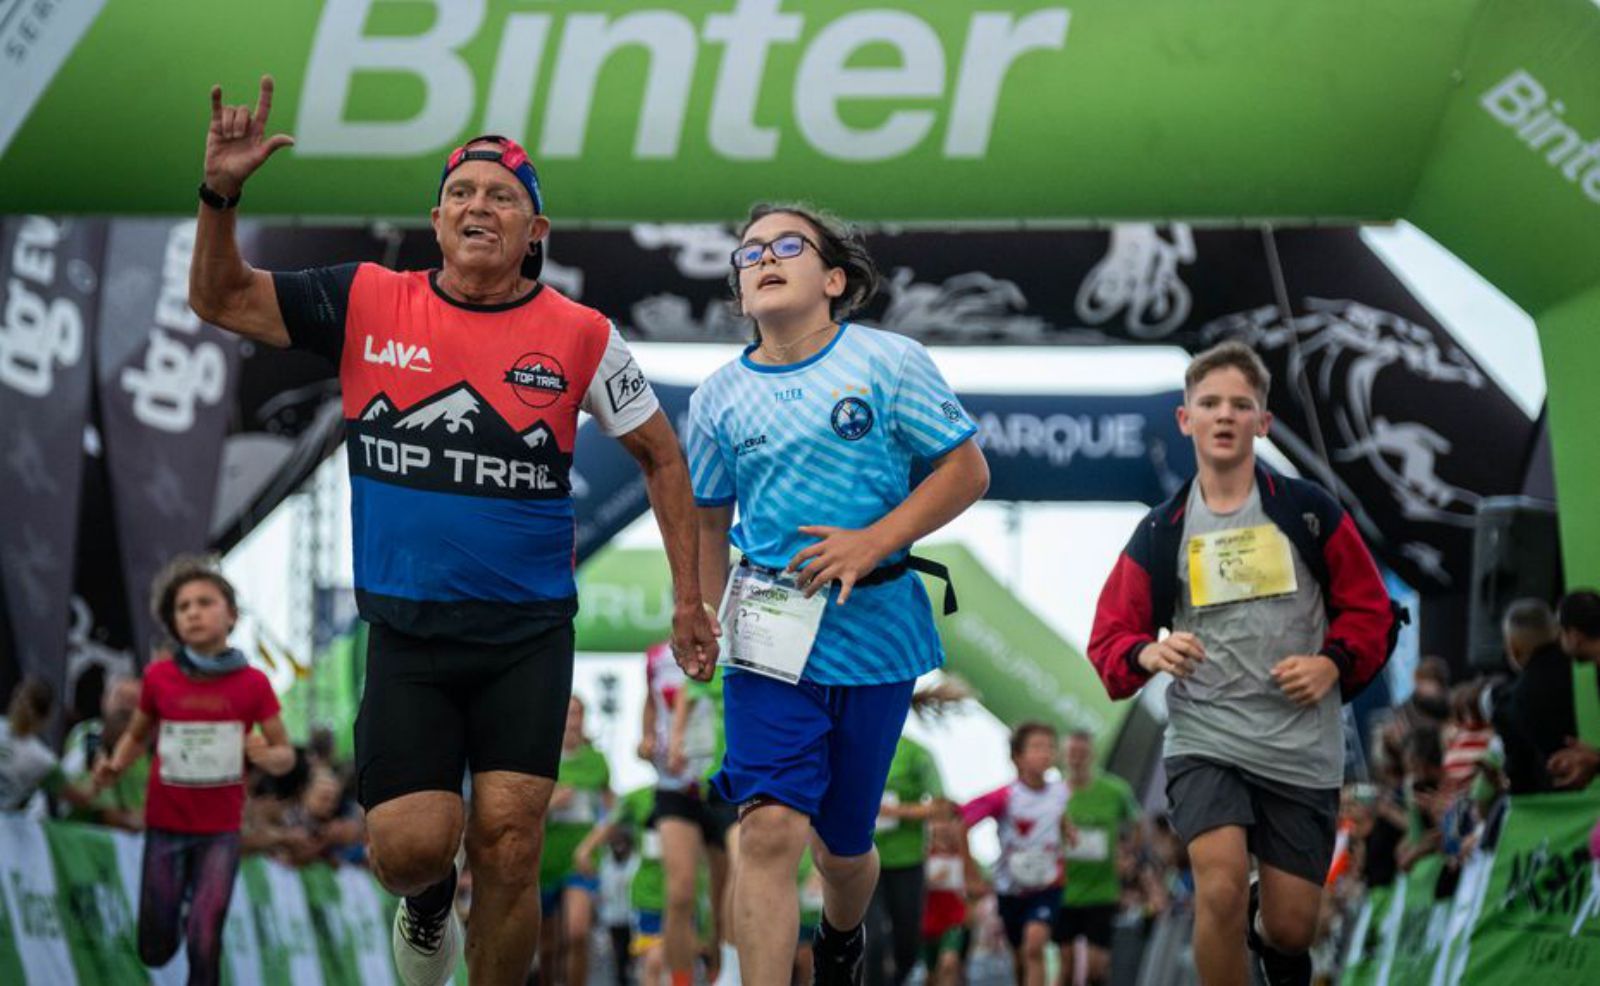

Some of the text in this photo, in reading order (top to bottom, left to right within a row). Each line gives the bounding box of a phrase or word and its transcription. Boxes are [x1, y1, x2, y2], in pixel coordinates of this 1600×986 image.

[295, 0, 1067, 162] Binter
[120, 326, 227, 432] dg
[513, 370, 534, 384] TOP
[359, 434, 431, 475] TOP
